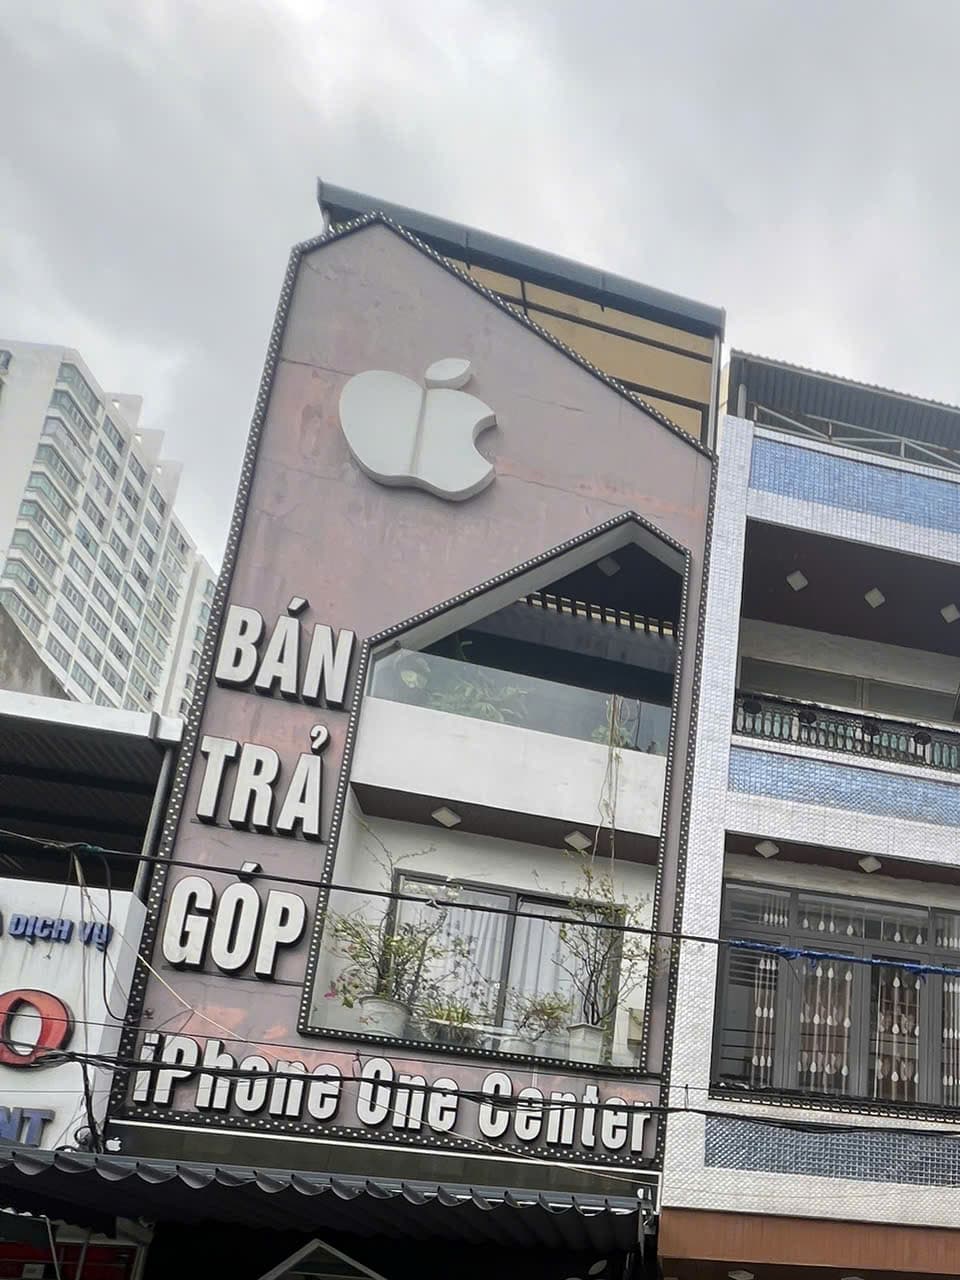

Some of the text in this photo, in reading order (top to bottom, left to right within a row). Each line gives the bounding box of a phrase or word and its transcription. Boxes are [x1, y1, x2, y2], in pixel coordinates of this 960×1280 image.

[215, 596, 355, 706] BÁN
[196, 724, 330, 838] TRẢ
[9, 913, 113, 950] DỊCH VỤ
[161, 863, 306, 979] GÓP
[133, 1033, 654, 1153] iPhone One Center
